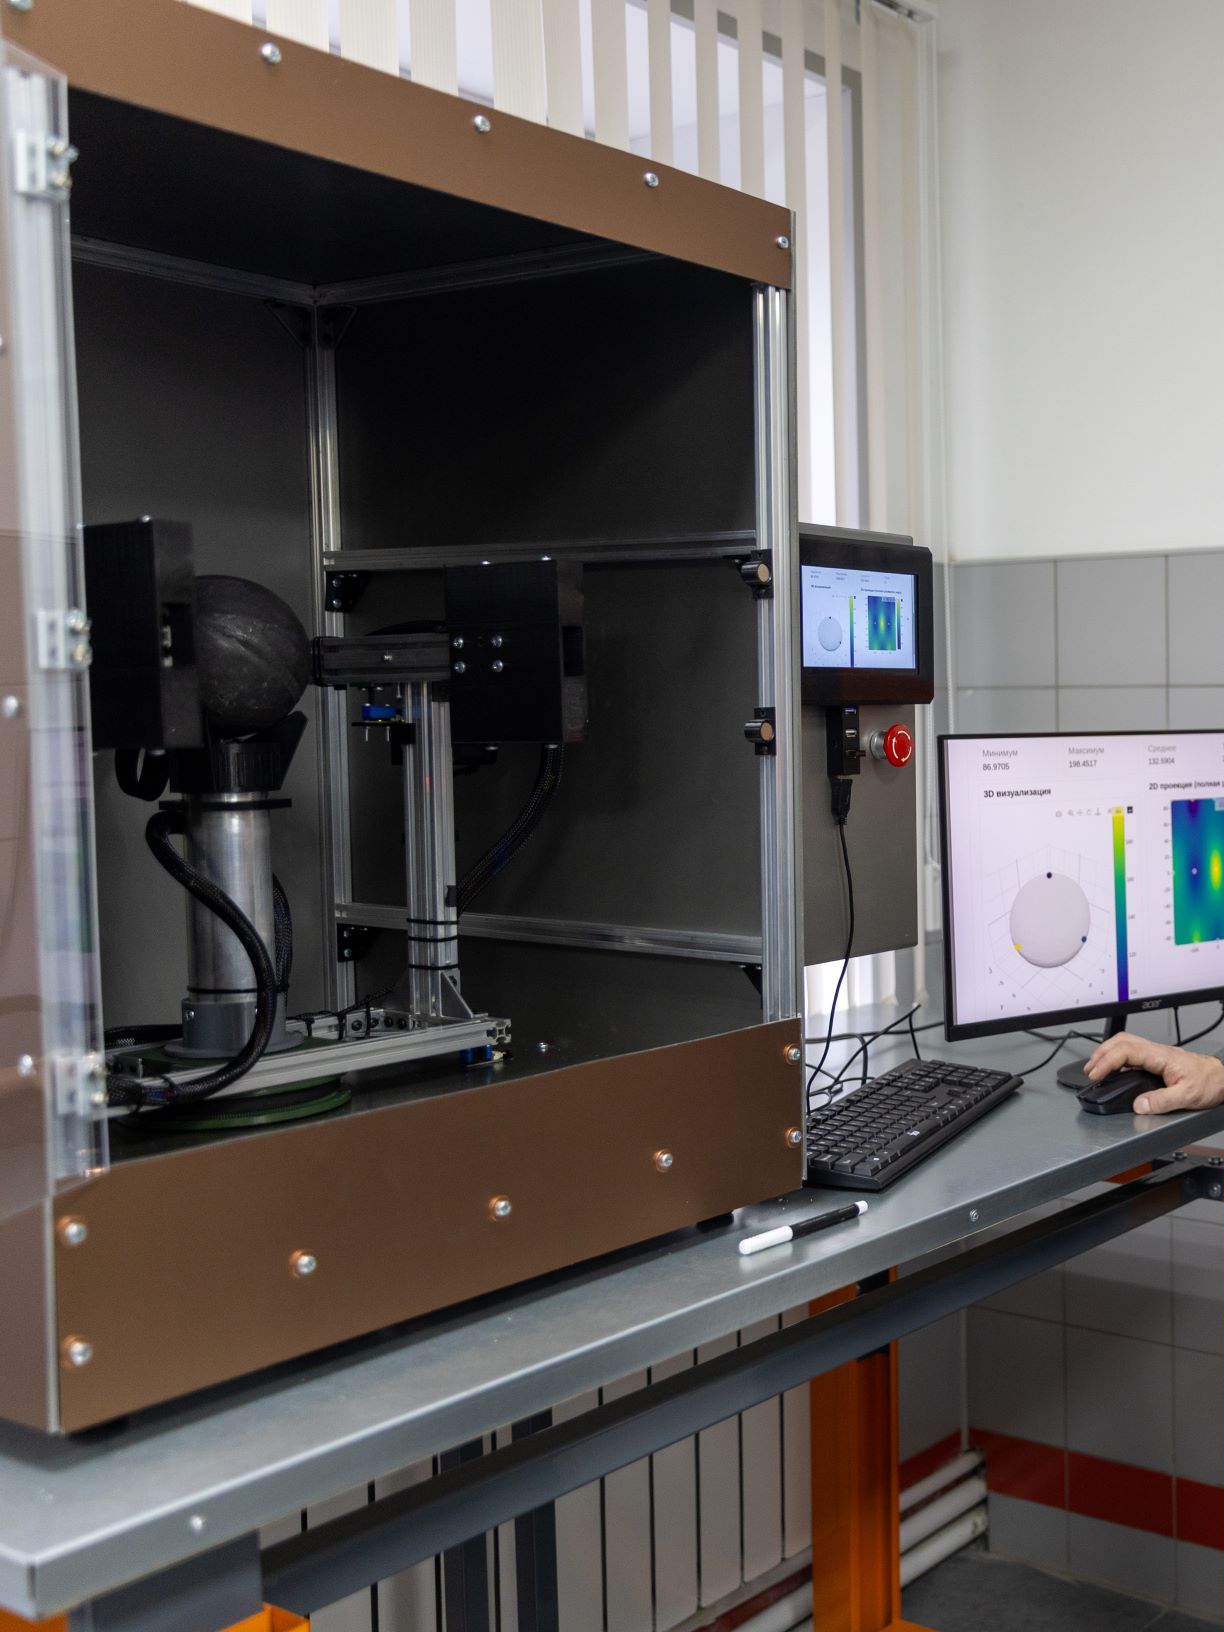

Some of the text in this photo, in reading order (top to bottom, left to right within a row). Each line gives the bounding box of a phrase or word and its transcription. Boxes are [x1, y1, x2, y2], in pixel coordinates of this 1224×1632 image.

[982, 749, 1019, 758] Минимум
[1068, 746, 1105, 756] Максимум
[982, 762, 1010, 771] 86.9705
[1148, 782, 1159, 790] 2D
[1160, 781, 1193, 791] проекция
[983, 788, 1052, 799] 3D визуализация
[1141, 1000, 1162, 1009] acer
